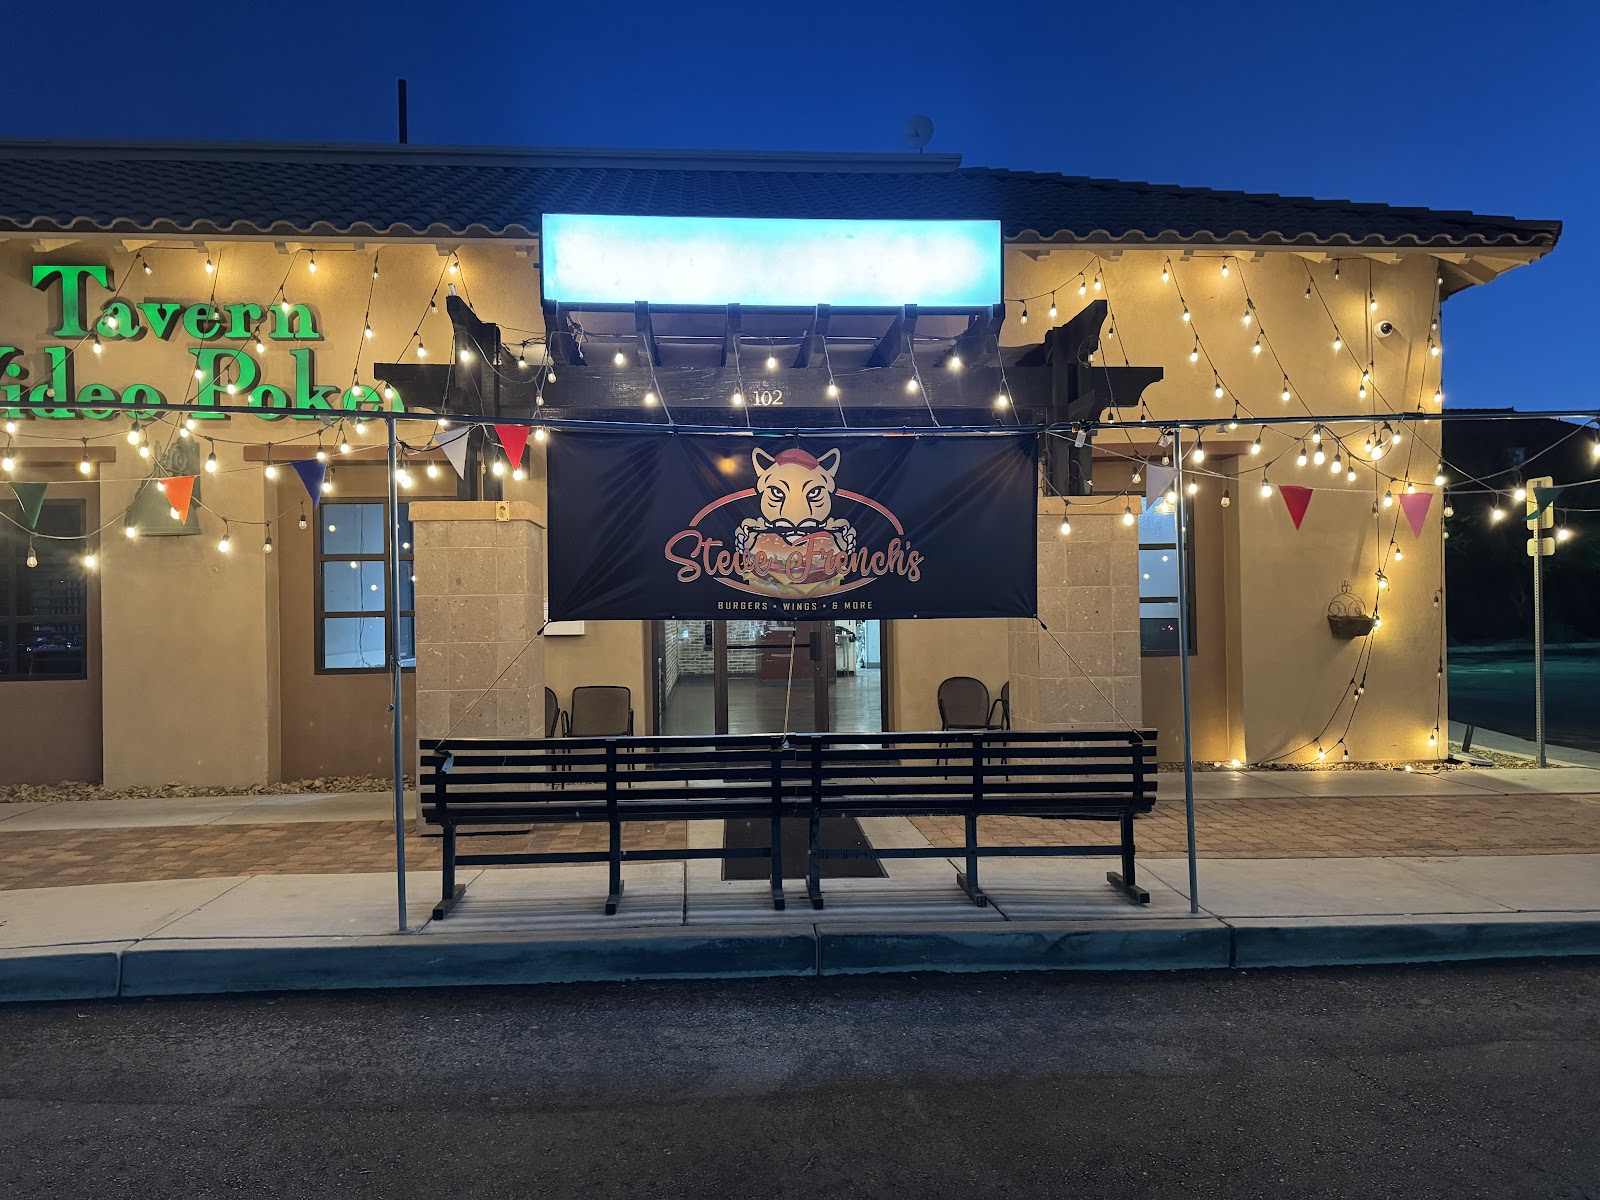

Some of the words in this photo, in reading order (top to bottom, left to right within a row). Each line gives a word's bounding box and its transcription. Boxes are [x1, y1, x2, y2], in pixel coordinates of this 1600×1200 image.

[31, 265, 321, 339] Tavern
[753, 390, 783, 406] 102
[664, 529, 772, 582] Steve
[785, 532, 924, 582] French's
[717, 601, 768, 611] BURGERS
[782, 602, 818, 611] WINGS
[831, 602, 839, 610] &
[844, 601, 873, 610] MORE
